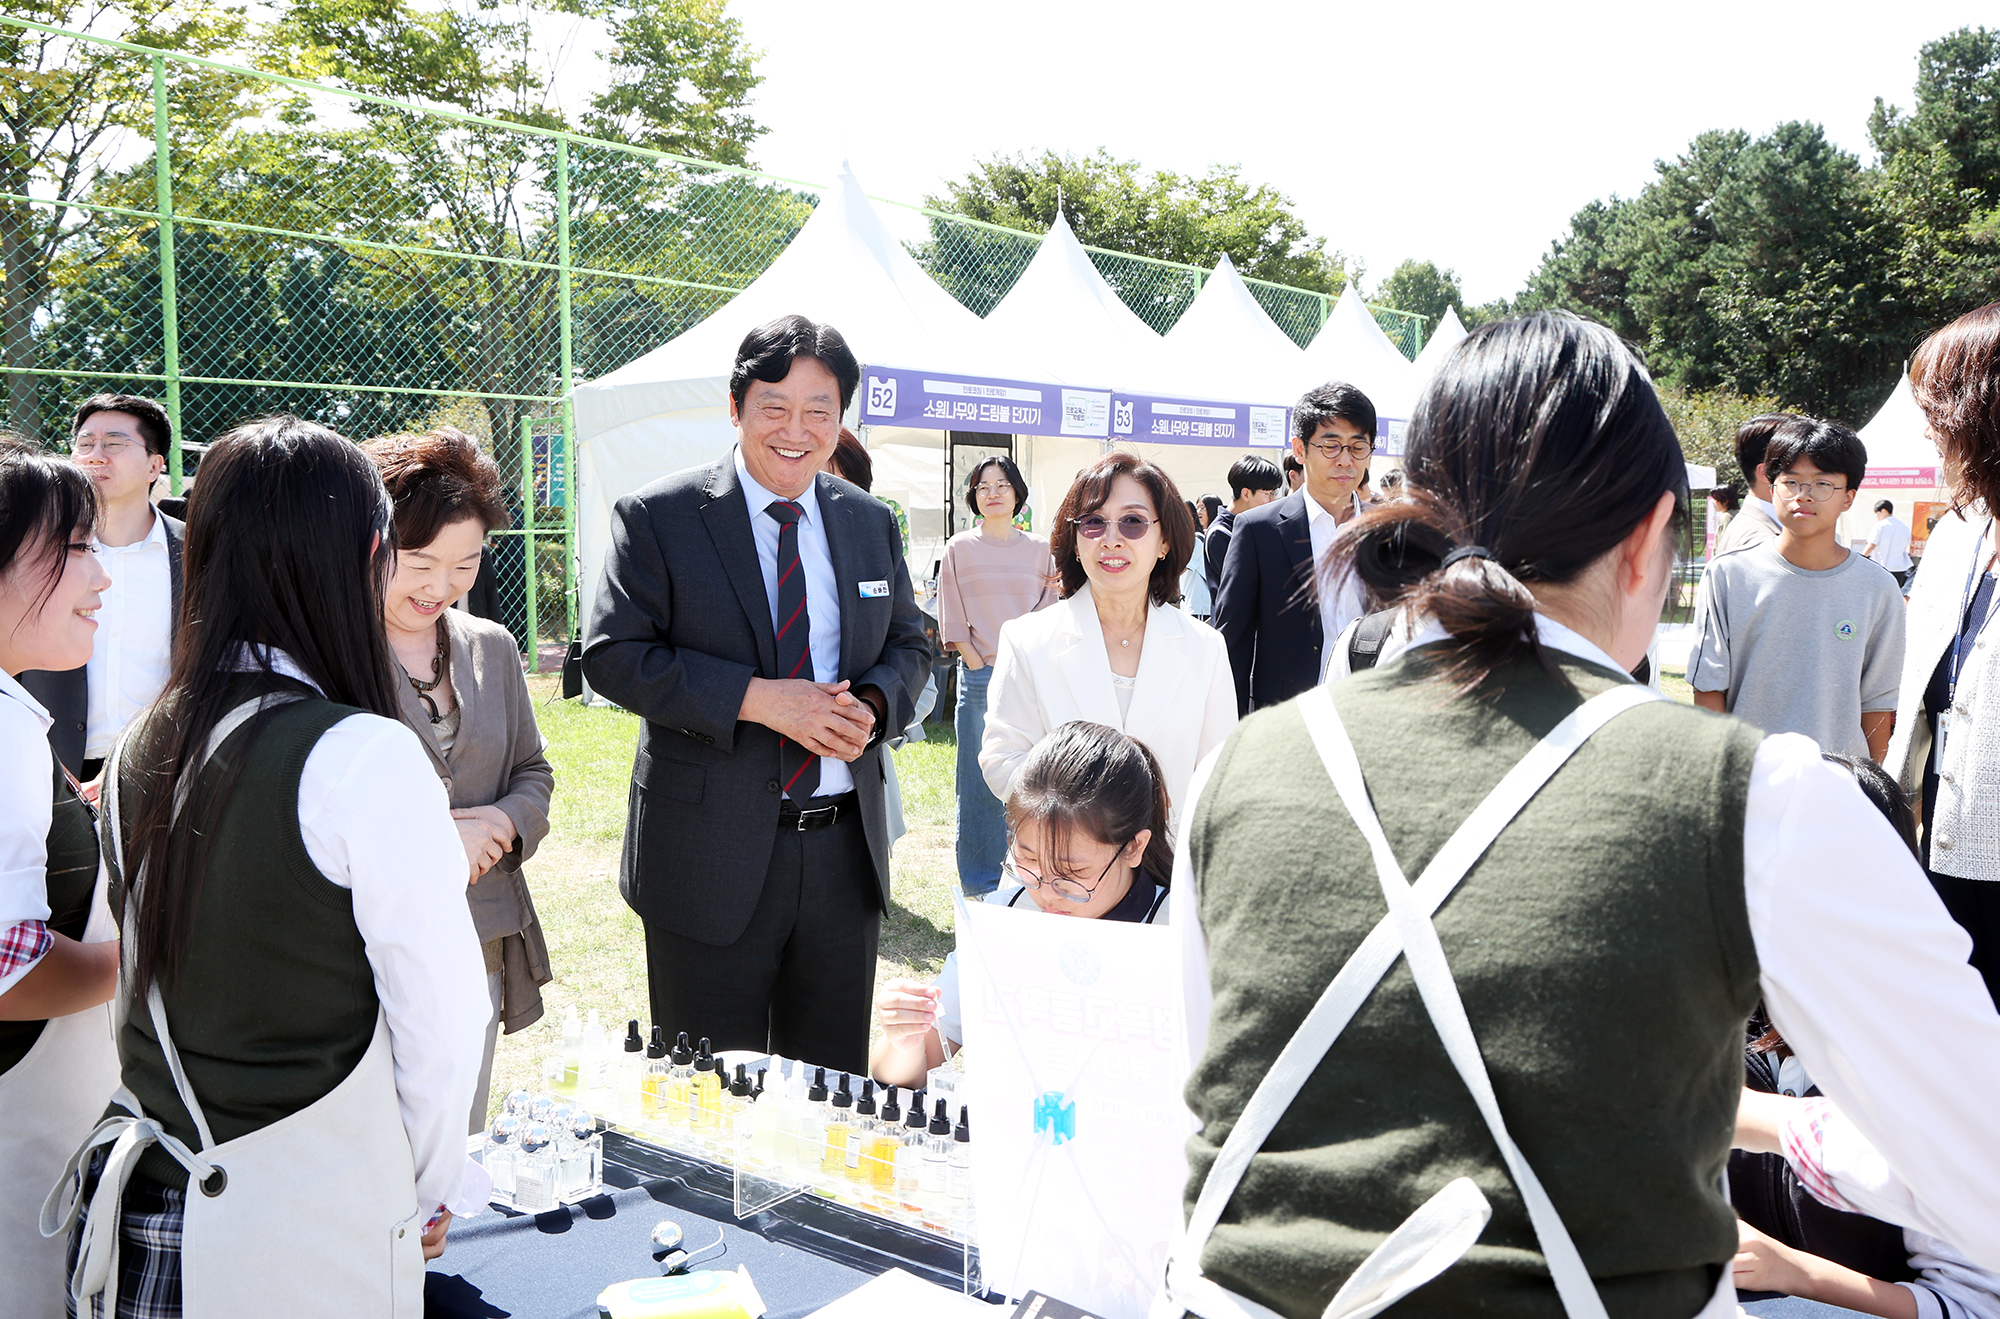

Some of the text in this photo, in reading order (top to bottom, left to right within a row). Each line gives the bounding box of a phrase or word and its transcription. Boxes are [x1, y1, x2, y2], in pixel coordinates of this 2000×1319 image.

[871, 387, 893, 409] 52
[922, 400, 1042, 426] 소원나무와 드림볼 던지기
[1116, 410, 1131, 427] 53
[1150, 419, 1190, 436] 소원나무와
[1190, 421, 1213, 438] 드림볼
[1214, 423, 1236, 439] 던지기
